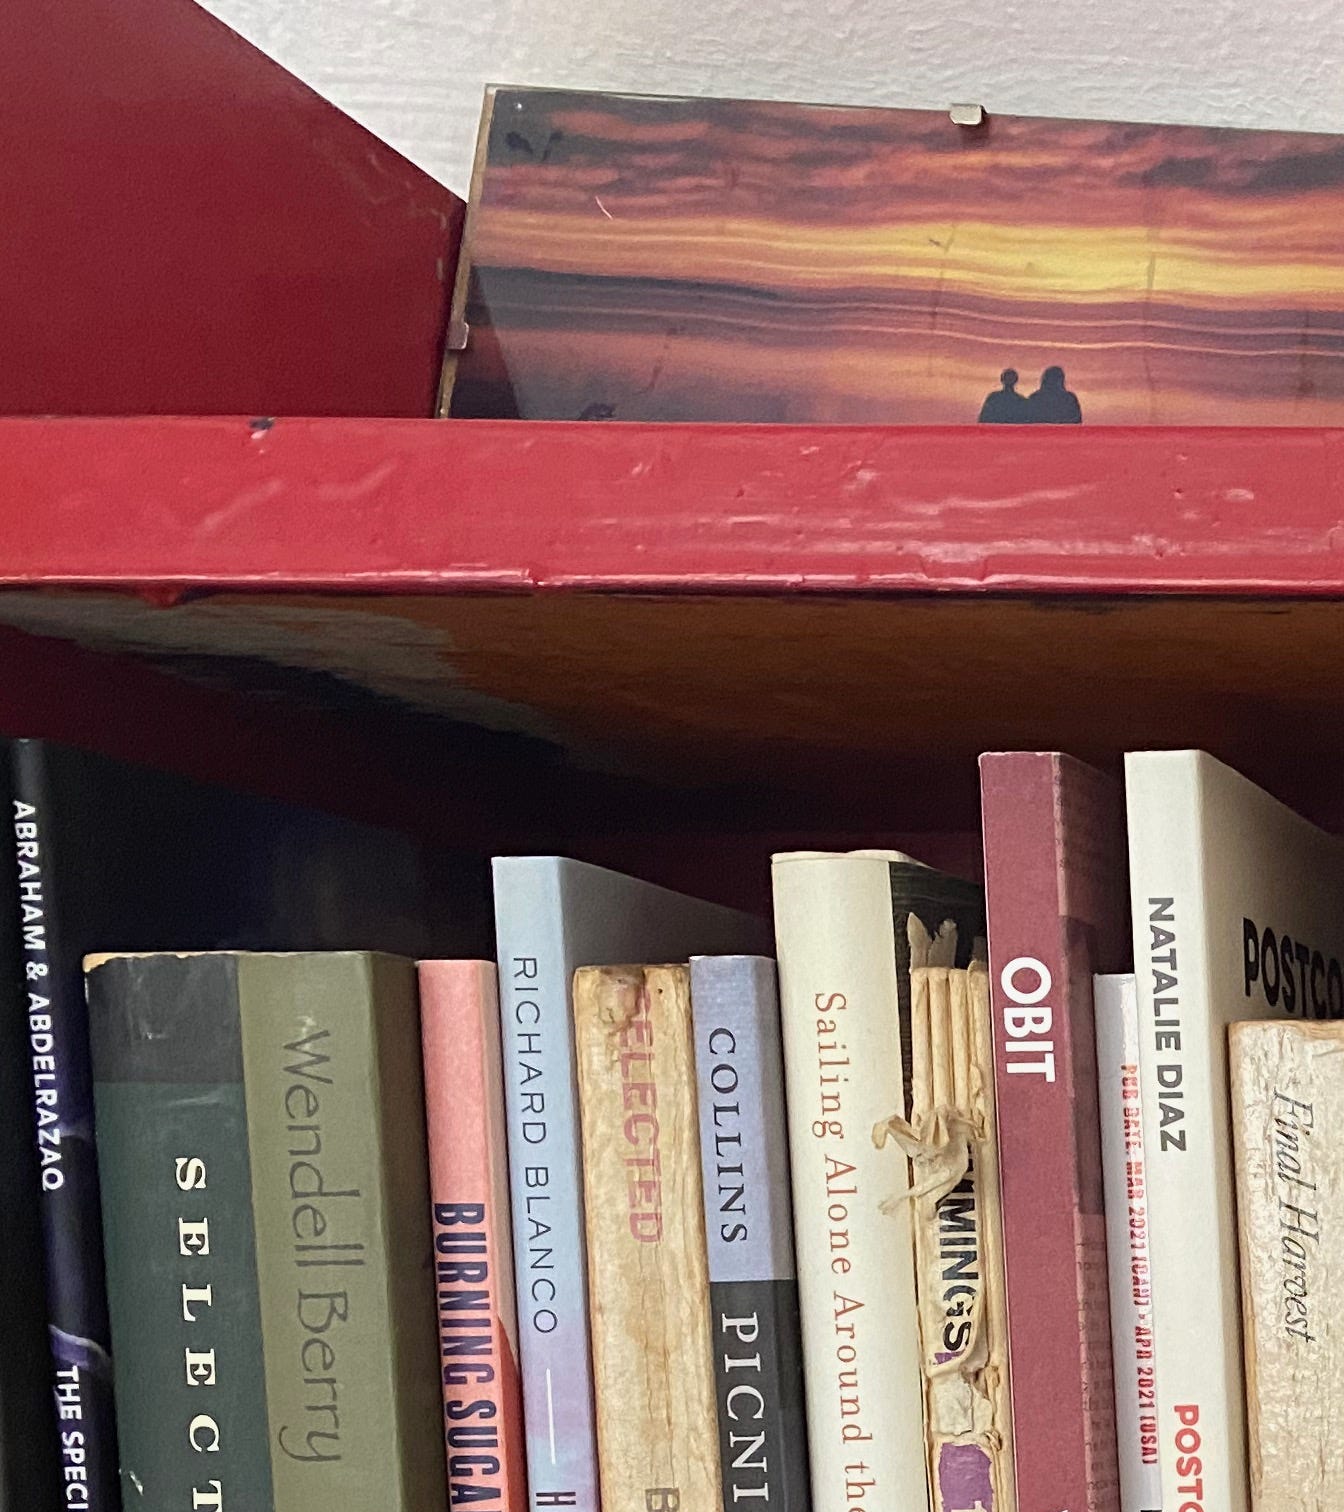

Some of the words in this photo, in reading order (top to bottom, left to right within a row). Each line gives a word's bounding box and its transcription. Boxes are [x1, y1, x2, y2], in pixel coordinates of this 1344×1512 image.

[16, 799, 43, 951] ABRAHAM
[512, 956, 548, 1145] RICHARD
[1000, 954, 1055, 1084] OBIT
[1148, 897, 1180, 1055] NATALIE
[29, 993, 64, 1191] ABDELRAZAQ
[708, 1027, 746, 1245] COLLINS
[813, 991, 850, 1138] Sailing
[1156, 1066, 1188, 1153] DIAZ
[280, 1028, 365, 1270] Wendell
[825, 1152, 858, 1275] Alone
[431, 1202, 494, 1384] BURNING
[524, 1166, 557, 1334] BLANCO
[59, 1366, 81, 1419] THE
[279, 1284, 348, 1466] Berry
[834, 1288, 873, 1450] Around
